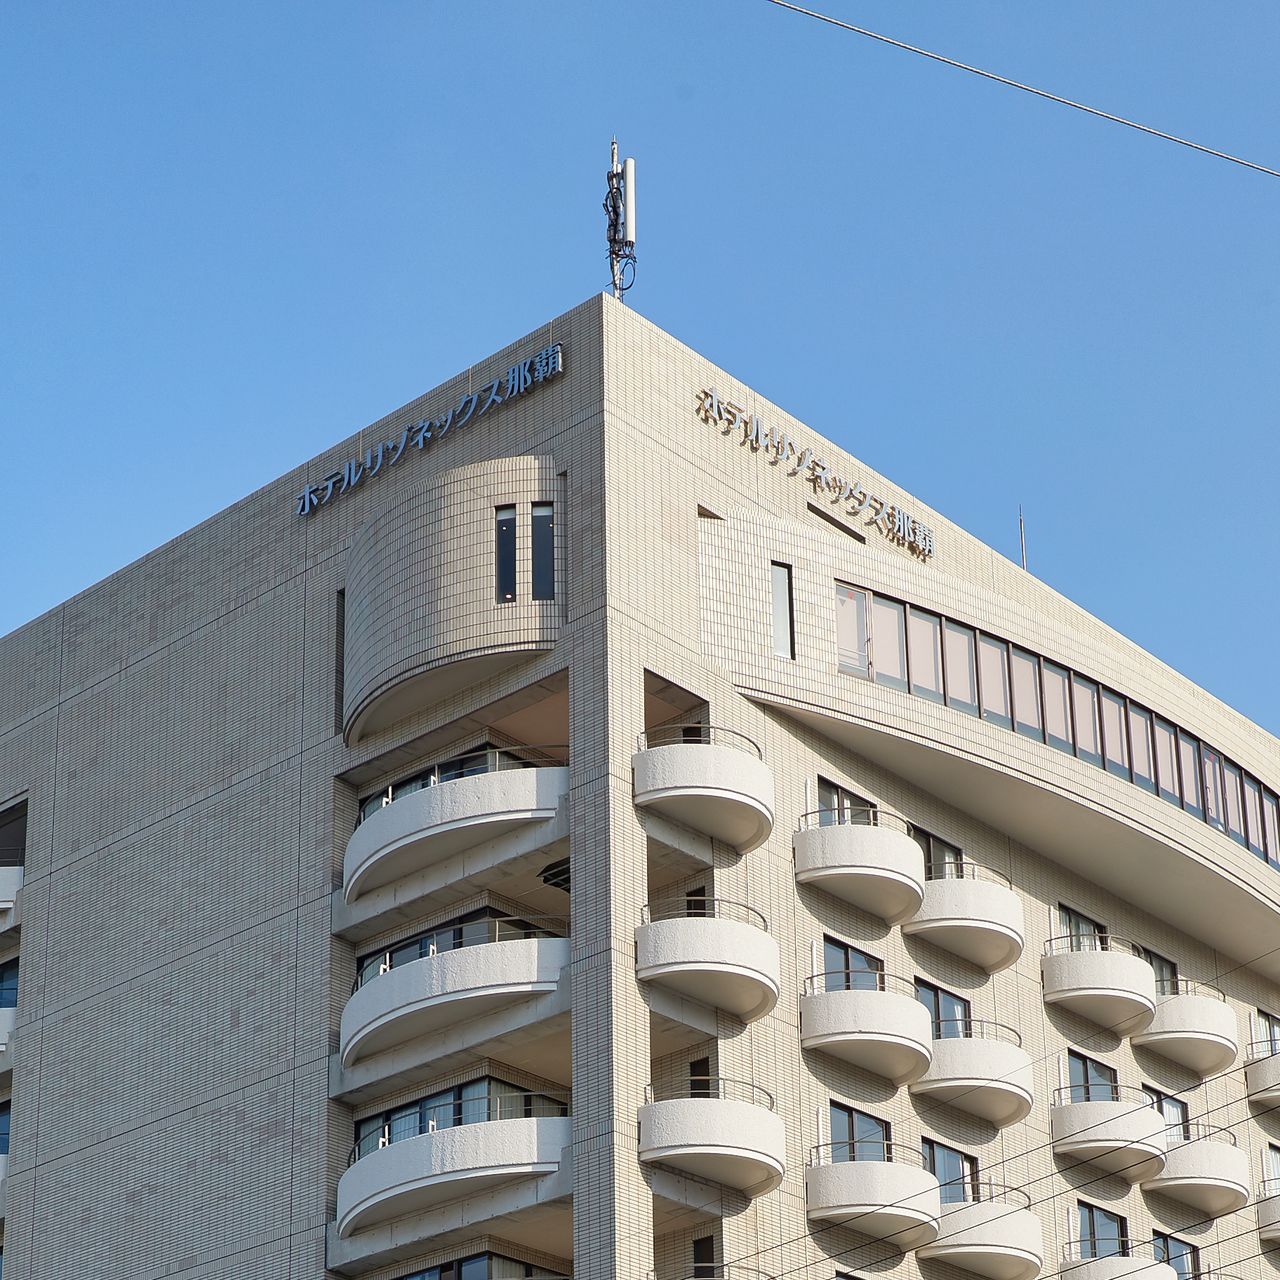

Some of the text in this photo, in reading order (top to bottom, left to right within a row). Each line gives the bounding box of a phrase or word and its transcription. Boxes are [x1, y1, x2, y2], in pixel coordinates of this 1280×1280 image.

[295, 341, 564, 516] ホテルリゾネックス那覇
[699, 386, 935, 556] ホテルリゾネックス那覇
